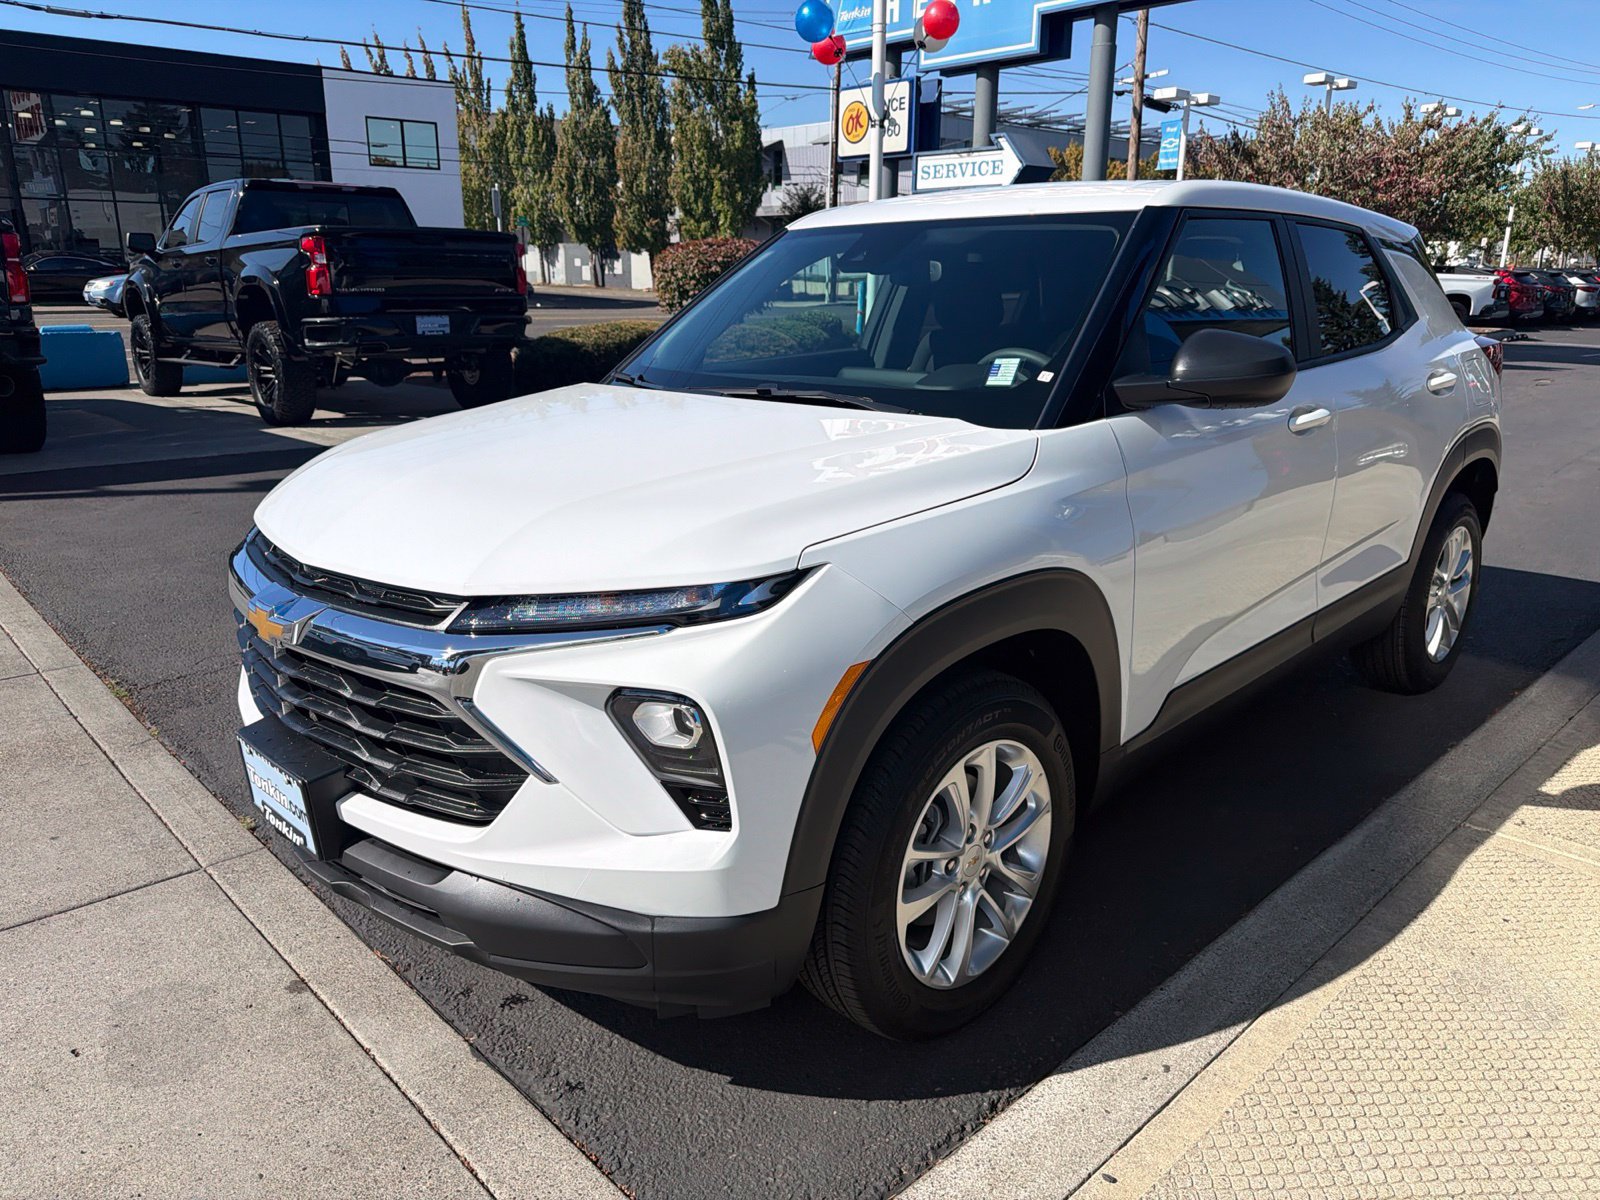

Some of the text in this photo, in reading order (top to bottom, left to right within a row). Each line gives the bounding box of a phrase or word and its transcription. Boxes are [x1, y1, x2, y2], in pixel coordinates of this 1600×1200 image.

[846, 108, 864, 136] OK
[920, 159, 1004, 181] SERVICE
[263, 804, 304, 847] Tonkin
